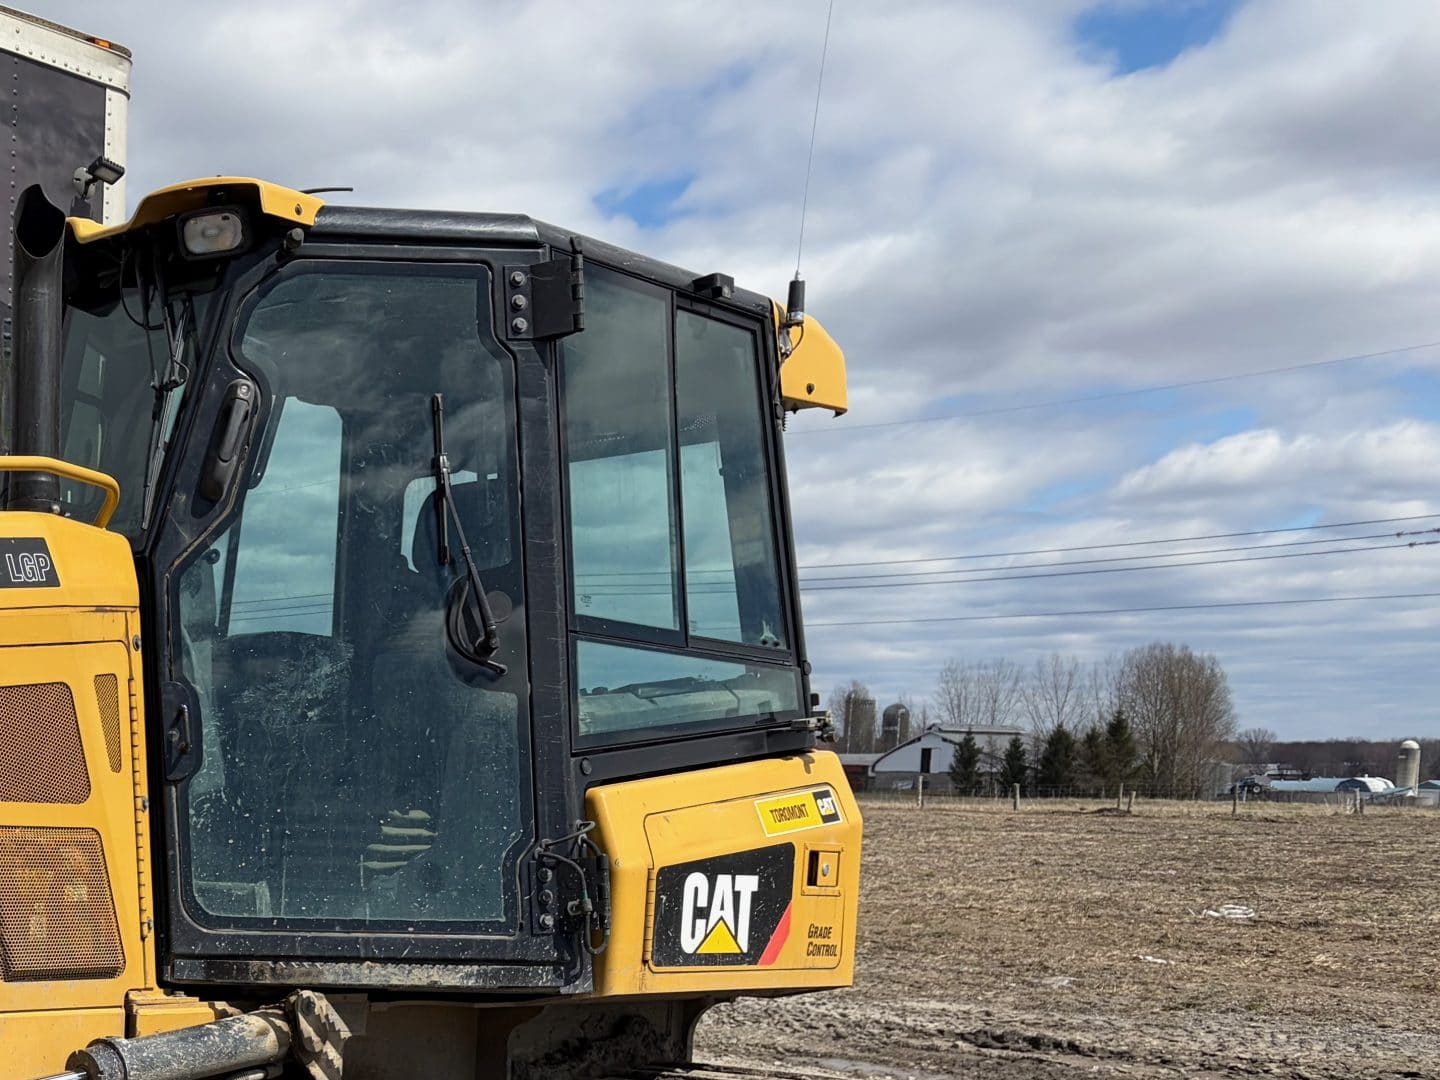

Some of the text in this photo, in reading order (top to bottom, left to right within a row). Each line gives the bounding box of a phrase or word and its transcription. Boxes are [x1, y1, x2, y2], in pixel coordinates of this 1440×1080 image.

[6, 553, 50, 582] LGP
[769, 797, 836, 824] TOROMONT CAT
[680, 872, 759, 954] CAT
[808, 923, 832, 939] GRADE
[807, 941, 837, 957] CONTROL
